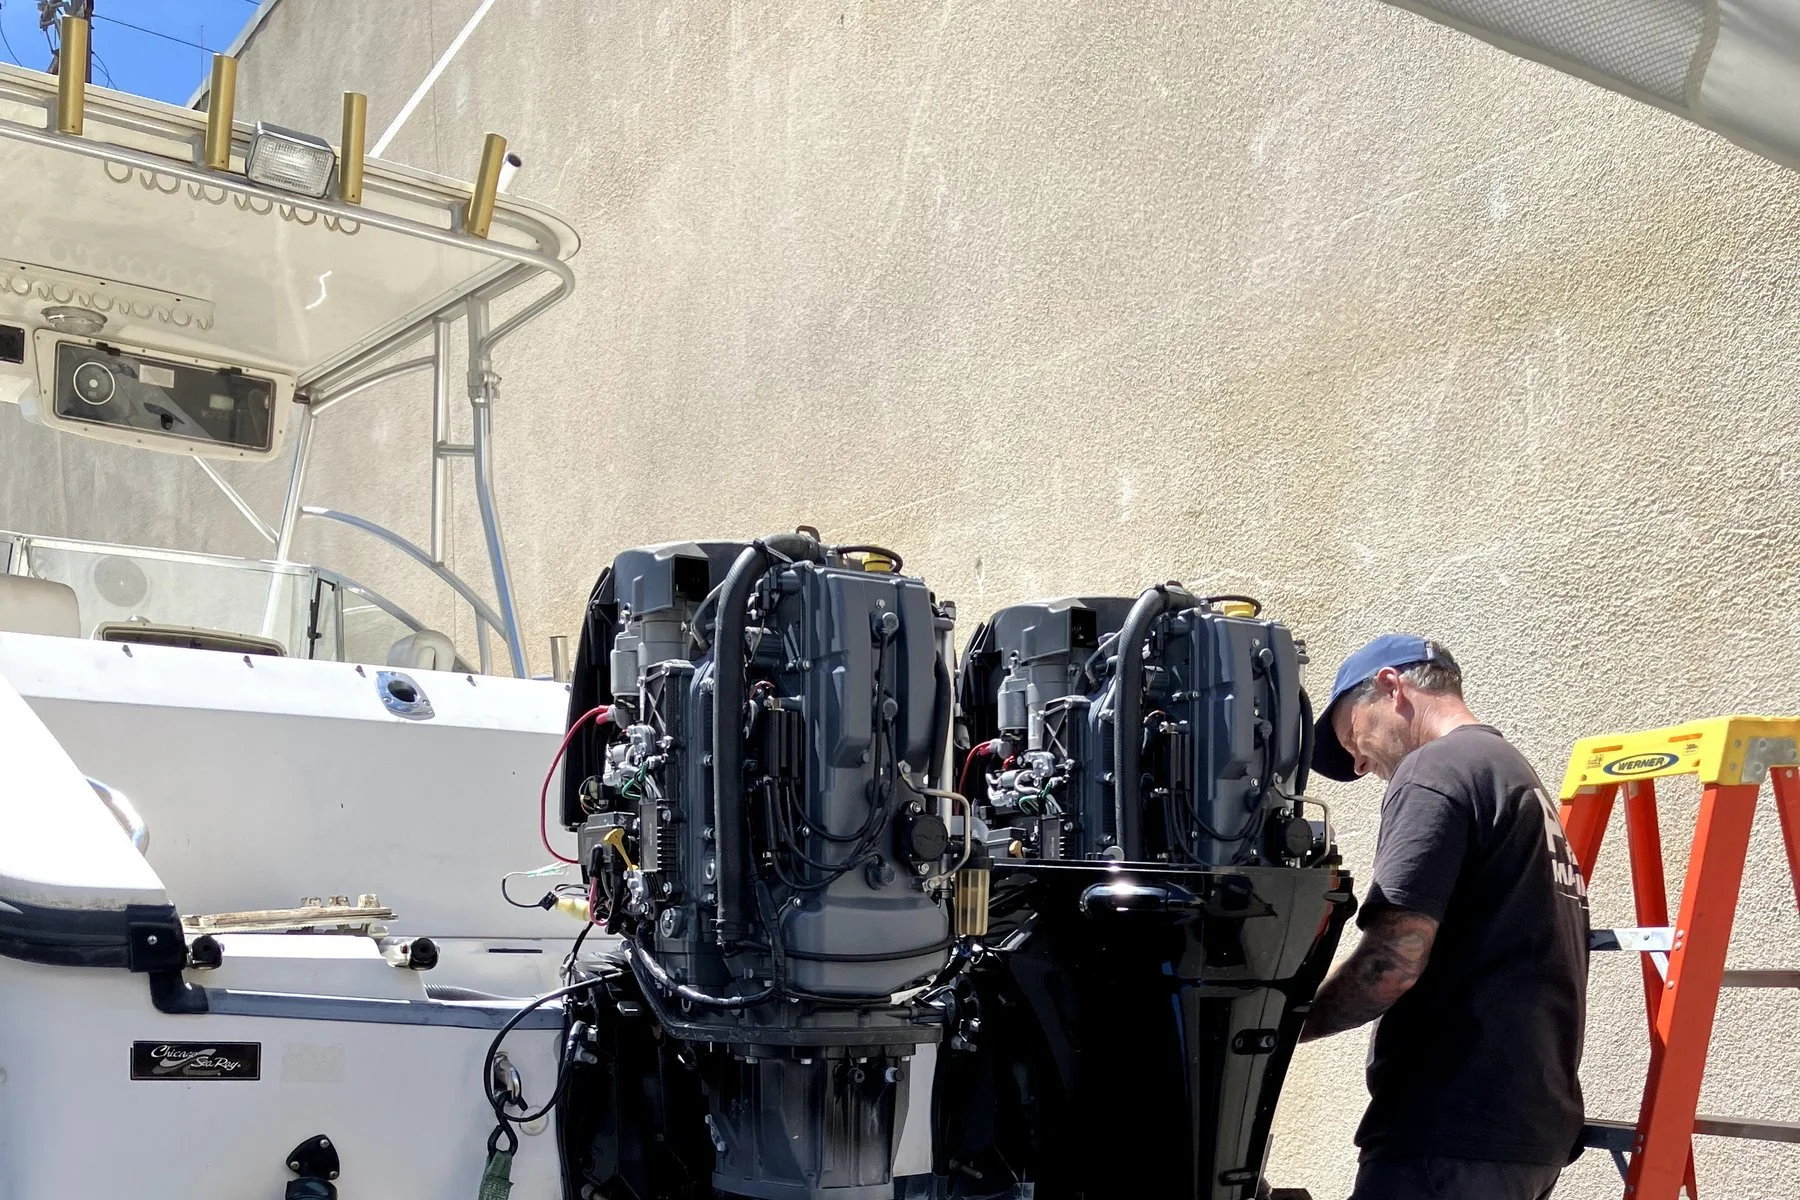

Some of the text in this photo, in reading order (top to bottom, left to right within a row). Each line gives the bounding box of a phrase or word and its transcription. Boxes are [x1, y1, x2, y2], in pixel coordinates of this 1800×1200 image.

[1617, 756, 1664, 771] WERNER
[190, 1056, 239, 1071] Sea Ray
